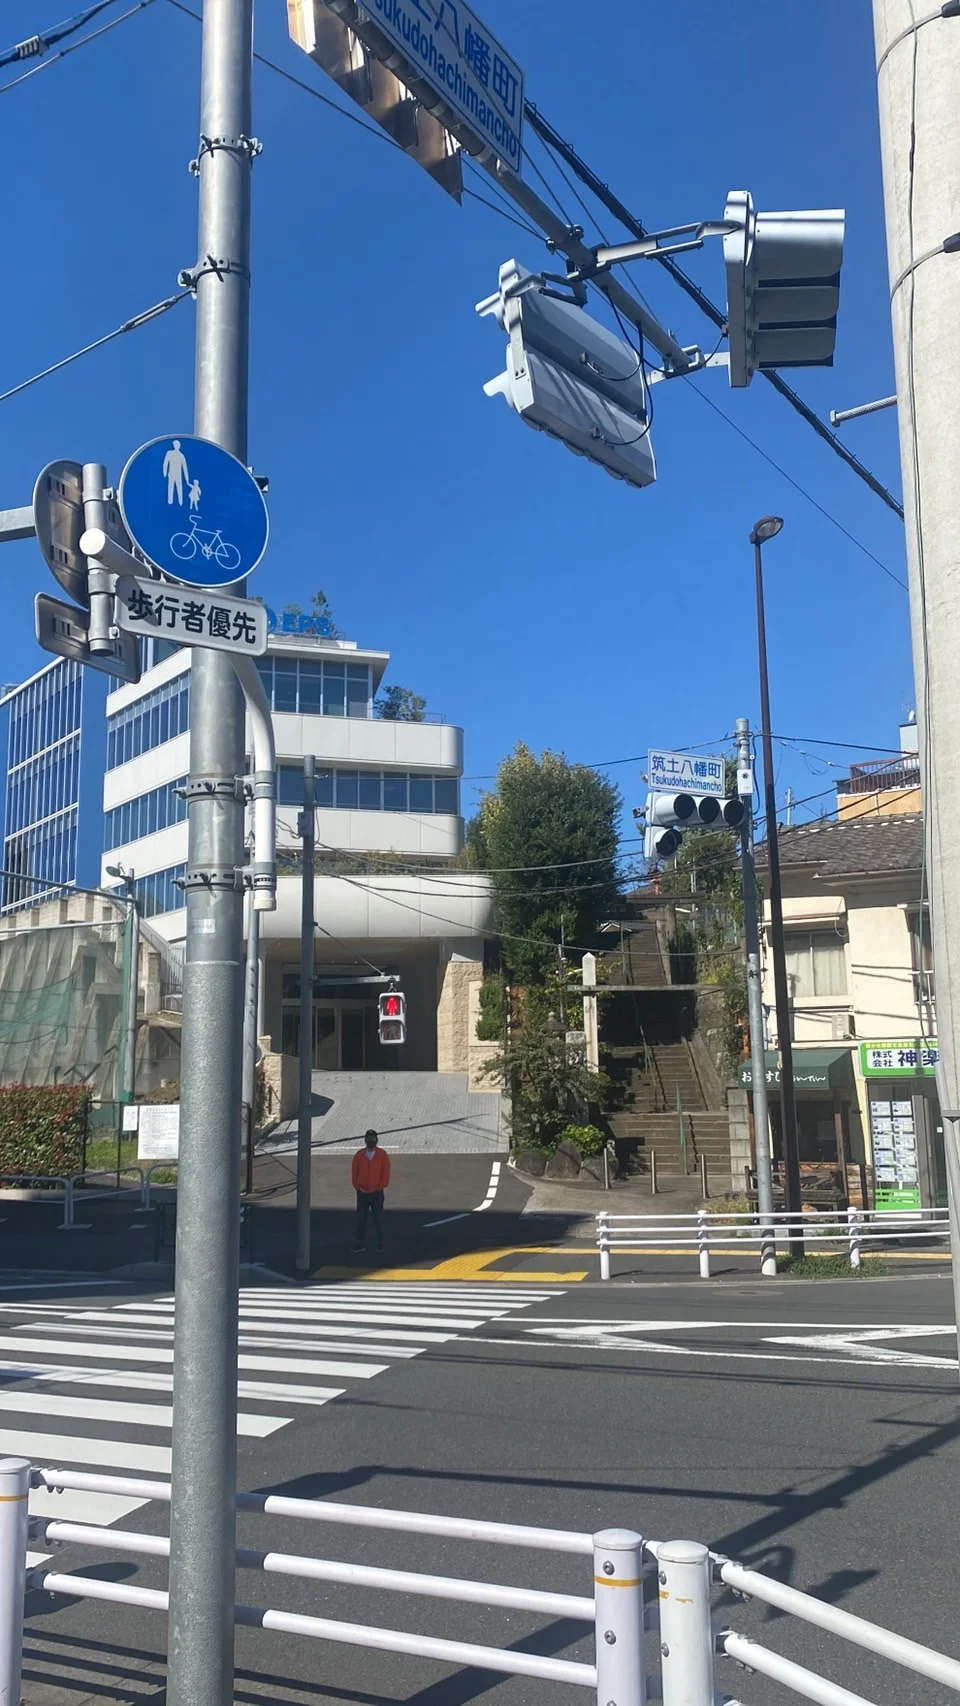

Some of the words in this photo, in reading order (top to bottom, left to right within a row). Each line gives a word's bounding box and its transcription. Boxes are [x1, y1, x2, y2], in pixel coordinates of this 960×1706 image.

[127, 589, 257, 644] 歩行者優先
[282, 613, 330, 636] EPS
[651, 755, 721, 779] 筑土八幡町
[651, 772, 723, 792] Tsukudohachimancho
[872, 1050, 892, 1058] 株式
[872, 1059, 893, 1067] 会社
[741, 1070, 781, 1083] おす
